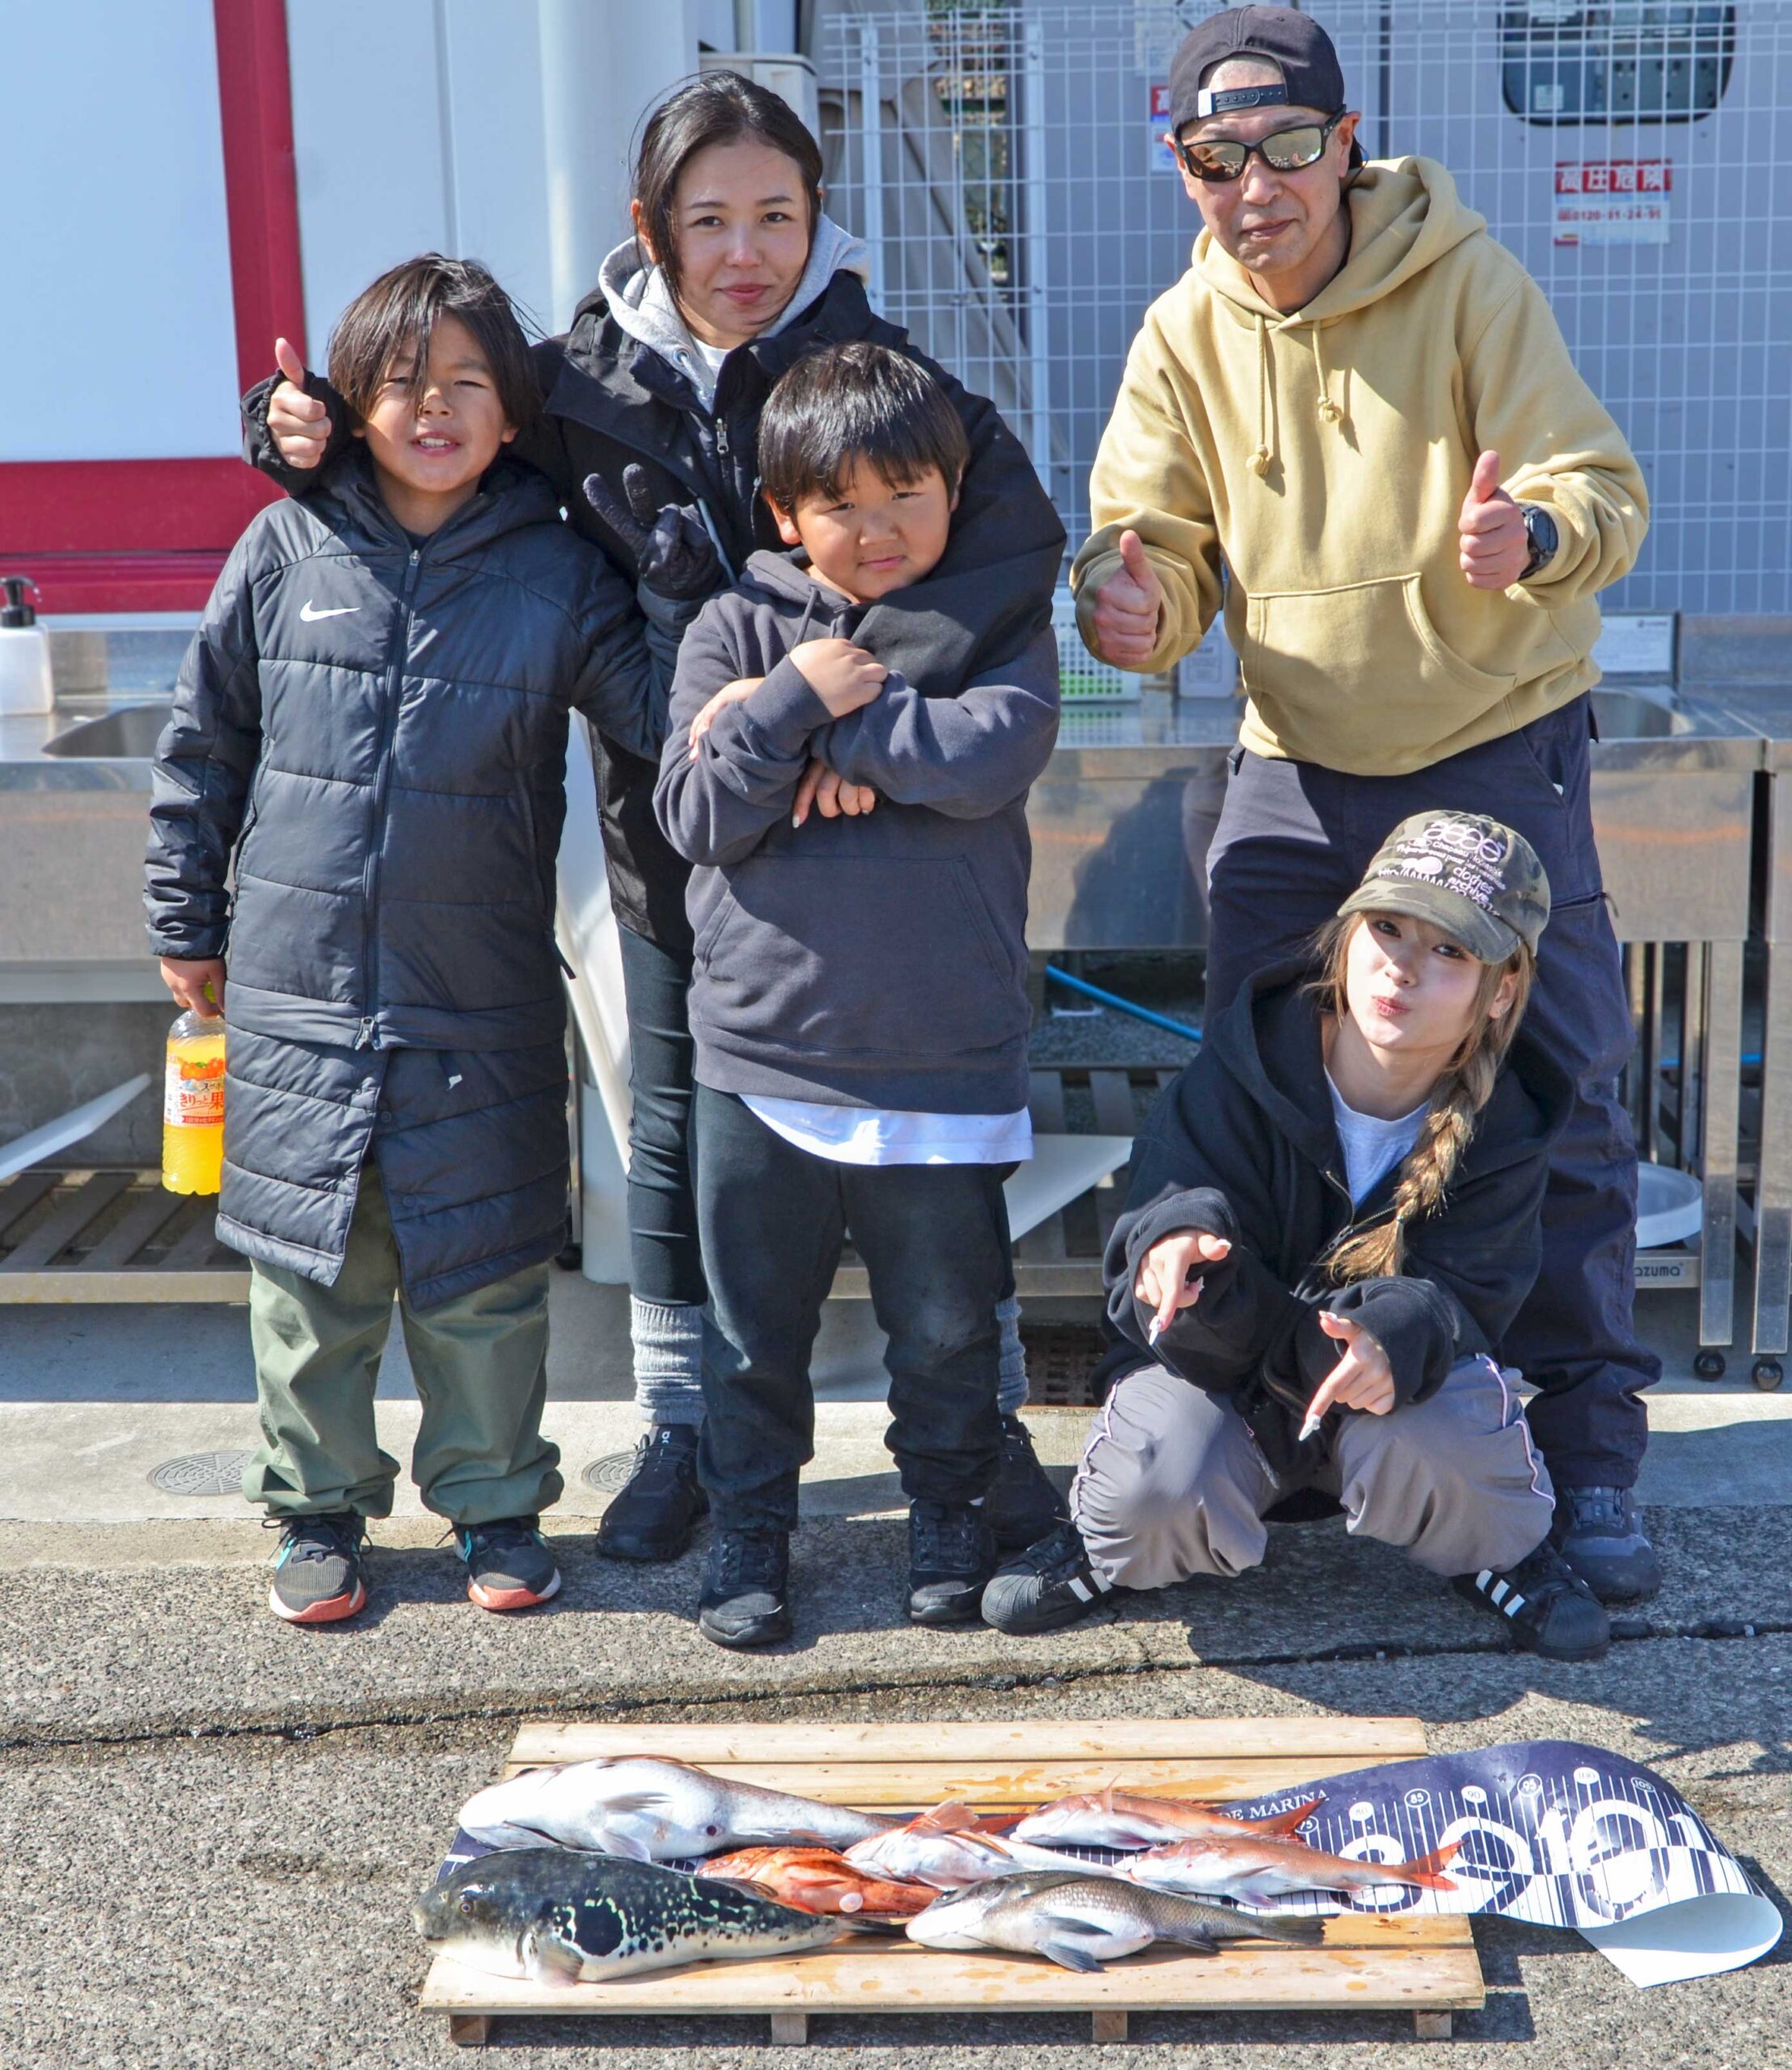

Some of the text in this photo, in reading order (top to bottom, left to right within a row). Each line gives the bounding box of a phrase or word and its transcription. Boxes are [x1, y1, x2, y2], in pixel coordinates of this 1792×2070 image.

[1448, 877, 1490, 903] archive
[1453, 867, 1494, 895] clothes
[1249, 1789, 1330, 1819] MARINA
[1410, 1792, 1424, 1803] 85
[1467, 1789, 1481, 1799] 90
[1522, 1779, 1536, 1791] 95
[1634, 1779, 1652, 1791] 105
